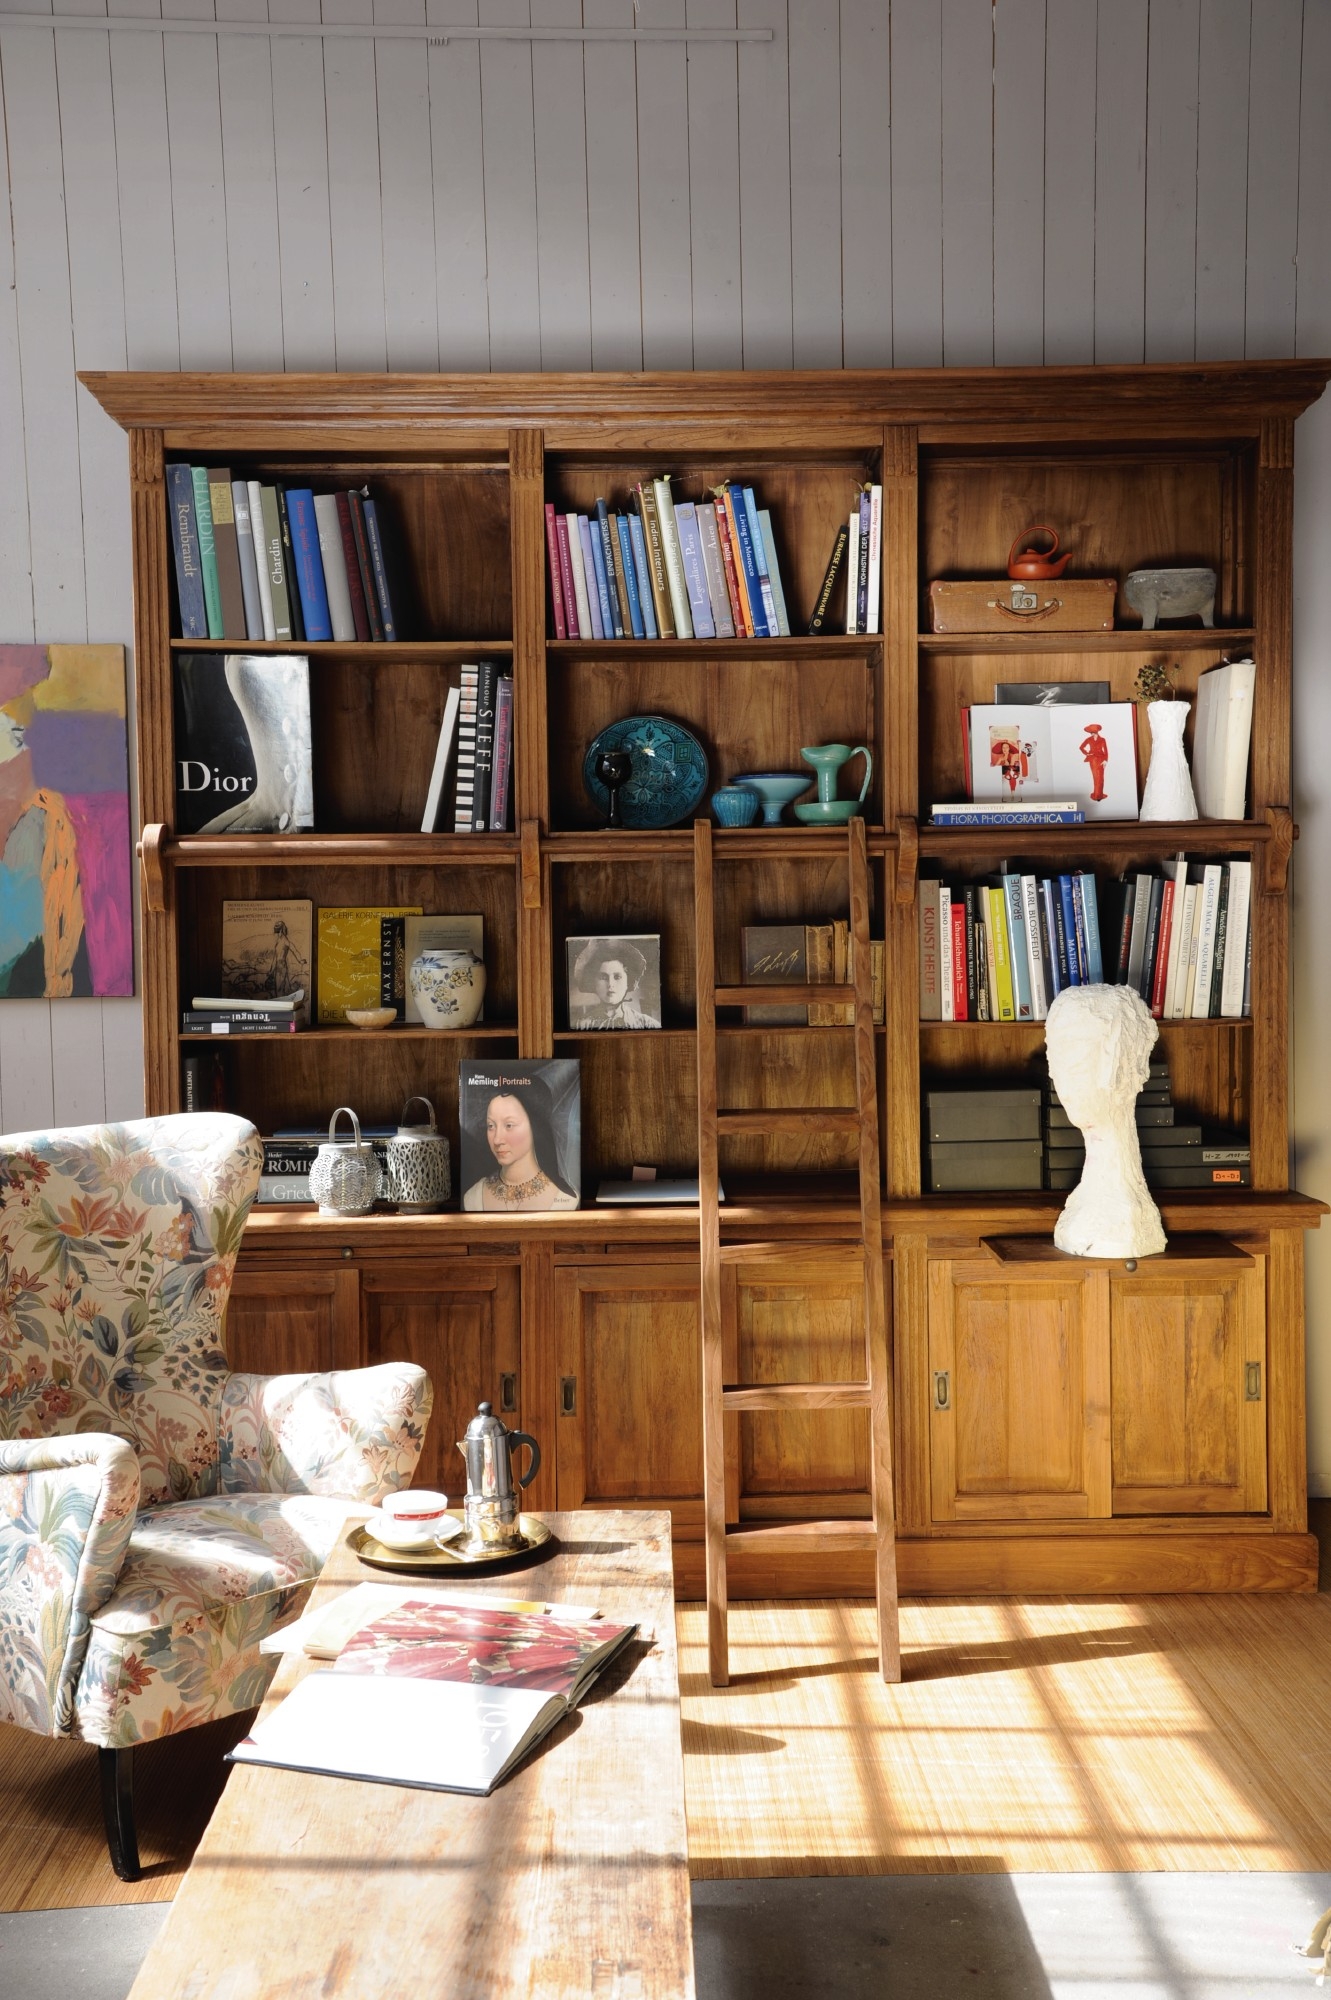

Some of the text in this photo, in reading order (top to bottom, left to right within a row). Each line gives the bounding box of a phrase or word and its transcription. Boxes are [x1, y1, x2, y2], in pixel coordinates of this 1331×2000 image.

[192, 468, 216, 556] CHARDIN
[861, 520, 869, 536] WELT
[177, 503, 198, 578] Rembrandt
[601, 518, 611, 554] WEISS!
[609, 522, 624, 577] SHABBY CHIC
[707, 525, 718, 549] Asien
[722, 542, 732, 561] india
[738, 514, 750, 537] Living
[744, 546, 756, 577] Morocco
[861, 536, 869, 550] DER
[269, 538, 283, 585] Chardin
[605, 554, 615, 577] EINFACH
[649, 520, 666, 592] Indien Interieurs
[664, 520, 684, 601] New Paris Interiors
[685, 533, 706, 605] Legendäres Paris
[817, 533, 847, 616] BURMESE LACQUERWARE
[859, 550, 868, 586] WOHNSTILE
[553, 578, 561, 604] LONDON
[599, 584, 610, 618] FRANCE
[476, 666, 493, 773] JEANLOUP SIEFF
[499, 704, 511, 736] Textiles
[498, 745, 507, 757] the
[178, 761, 253, 793] Dior
[497, 758, 507, 787] Islamic
[494, 787, 506, 812] World
[951, 811, 1063, 824] FLORA PHOTOGRAPHICA
[322, 911, 354, 919] GALERIE
[355, 911, 395, 919] KORNFELD
[1010, 878, 1023, 921] BRAQUE
[1135, 885, 1145, 924] TIEPOLO
[1026, 883, 1041, 961] KARL BLOSSFELDT
[1180, 909, 1192, 966] WEISSENBRUCH
[1199, 877, 1215, 989] AUGUST MACKE AQUARELLE
[1215, 908, 1228, 970] Amedeo Modigliani
[382, 922, 392, 1002] MAX ERNST
[924, 907, 935, 994] KUNST HEUTE
[941, 894, 952, 992] Picasso und das Theater
[954, 920, 964, 981] Ichundichundich
[987, 939, 995, 968] PICASSO
[1067, 938, 1078, 976] MATISSE
[232, 1012, 271, 1022] Tenugui
[322, 1010, 339, 1019] DIE
[468, 1077, 499, 1087] Memling
